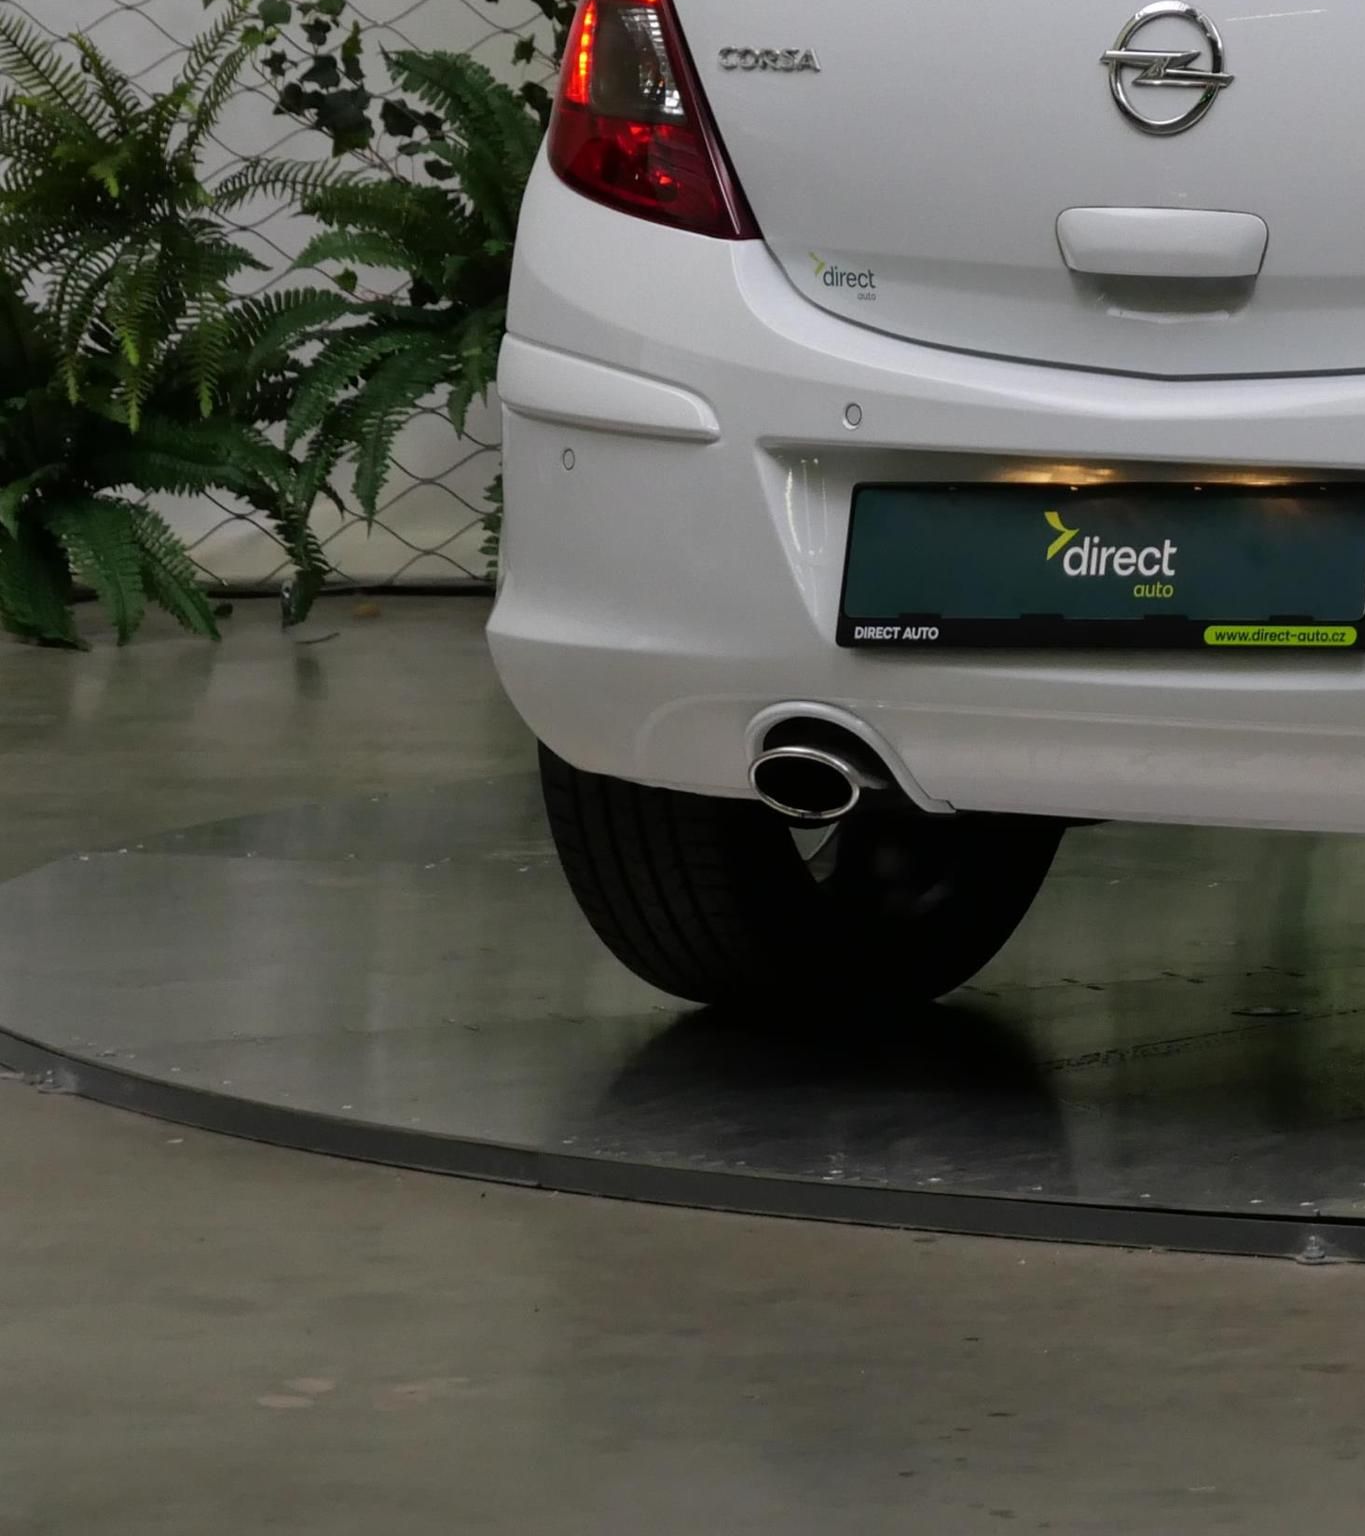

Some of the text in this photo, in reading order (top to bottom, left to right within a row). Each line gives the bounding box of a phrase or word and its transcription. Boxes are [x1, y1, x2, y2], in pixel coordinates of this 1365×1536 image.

[718, 46, 820, 72] CORSA
[823, 265, 876, 289] direct
[1063, 537, 1177, 576] direct
[1133, 581, 1174, 599] auto
[854, 626, 939, 639] DIRECT AUTO
[1215, 628, 1346, 642] www.direct-auto.cz
